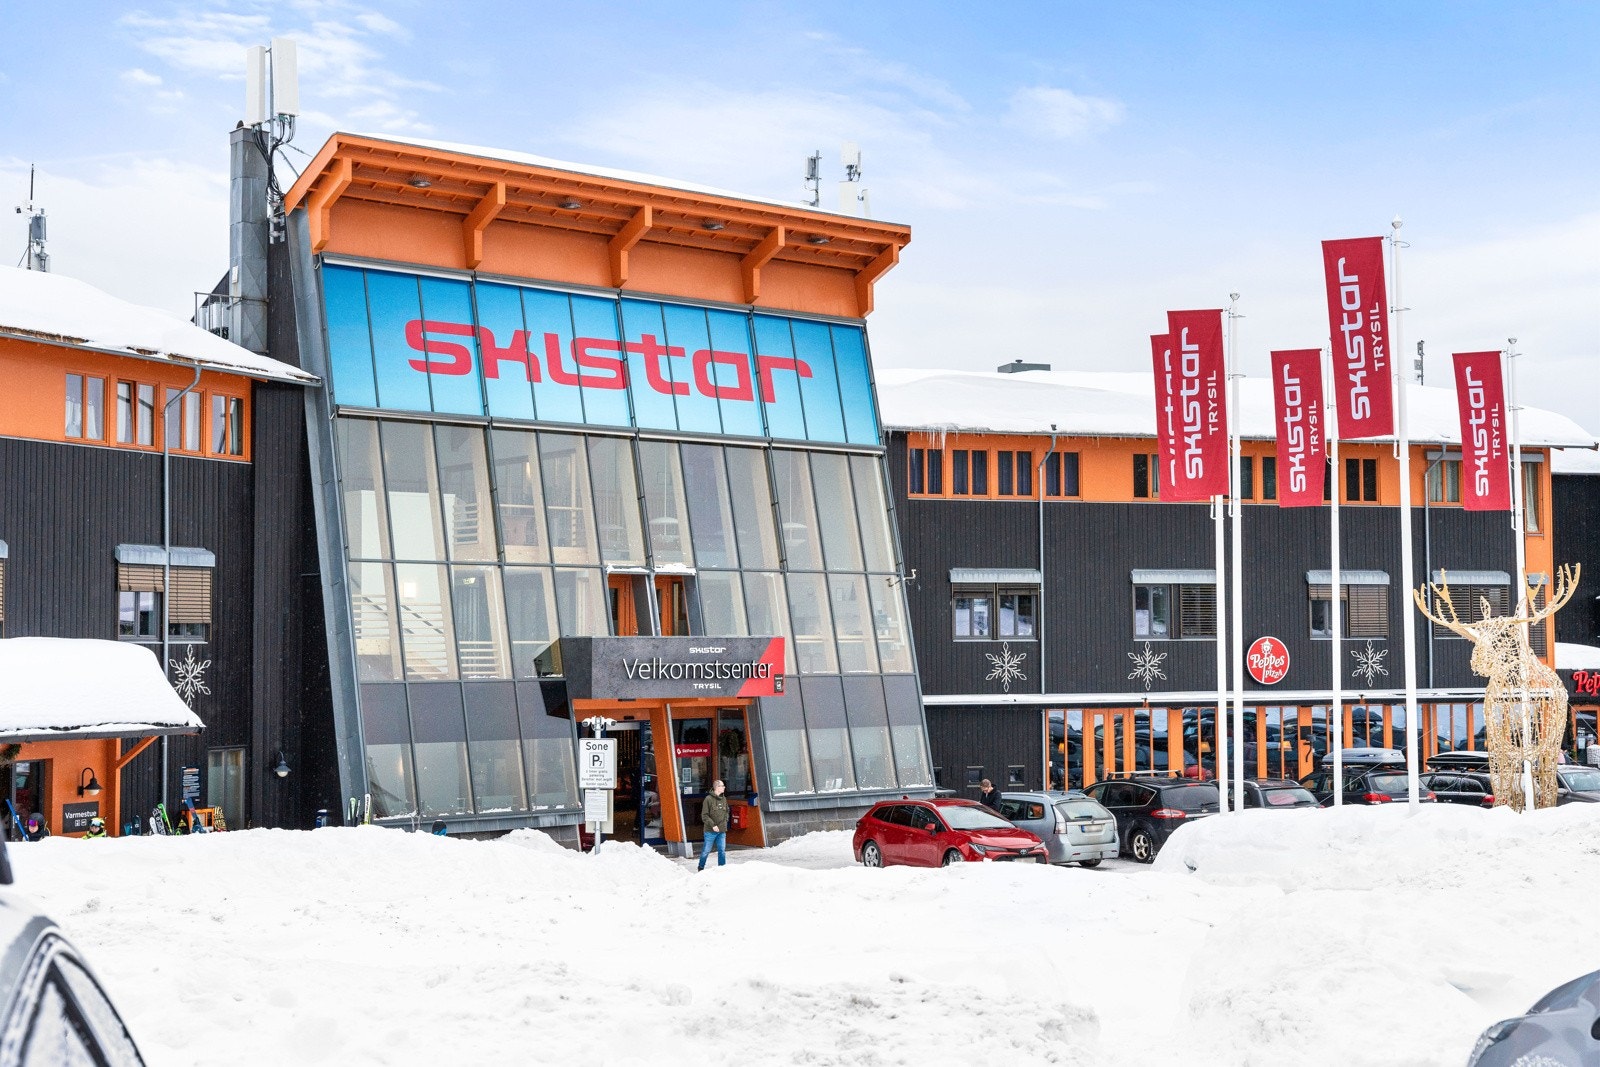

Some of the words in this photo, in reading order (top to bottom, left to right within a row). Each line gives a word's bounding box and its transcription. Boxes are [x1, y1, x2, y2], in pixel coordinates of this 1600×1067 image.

[1369, 302, 1385, 371] TRYSIL
[1207, 370, 1219, 435] TRYSIL
[1308, 400, 1320, 455] TRYSIL
[1491, 402, 1503, 459] TRYSIL
[622, 657, 774, 680] Velkomstsenter
[1250, 653, 1286, 670] Peppes
[585, 741, 609, 751] Sone
[64, 810, 97, 820] Varmestue
